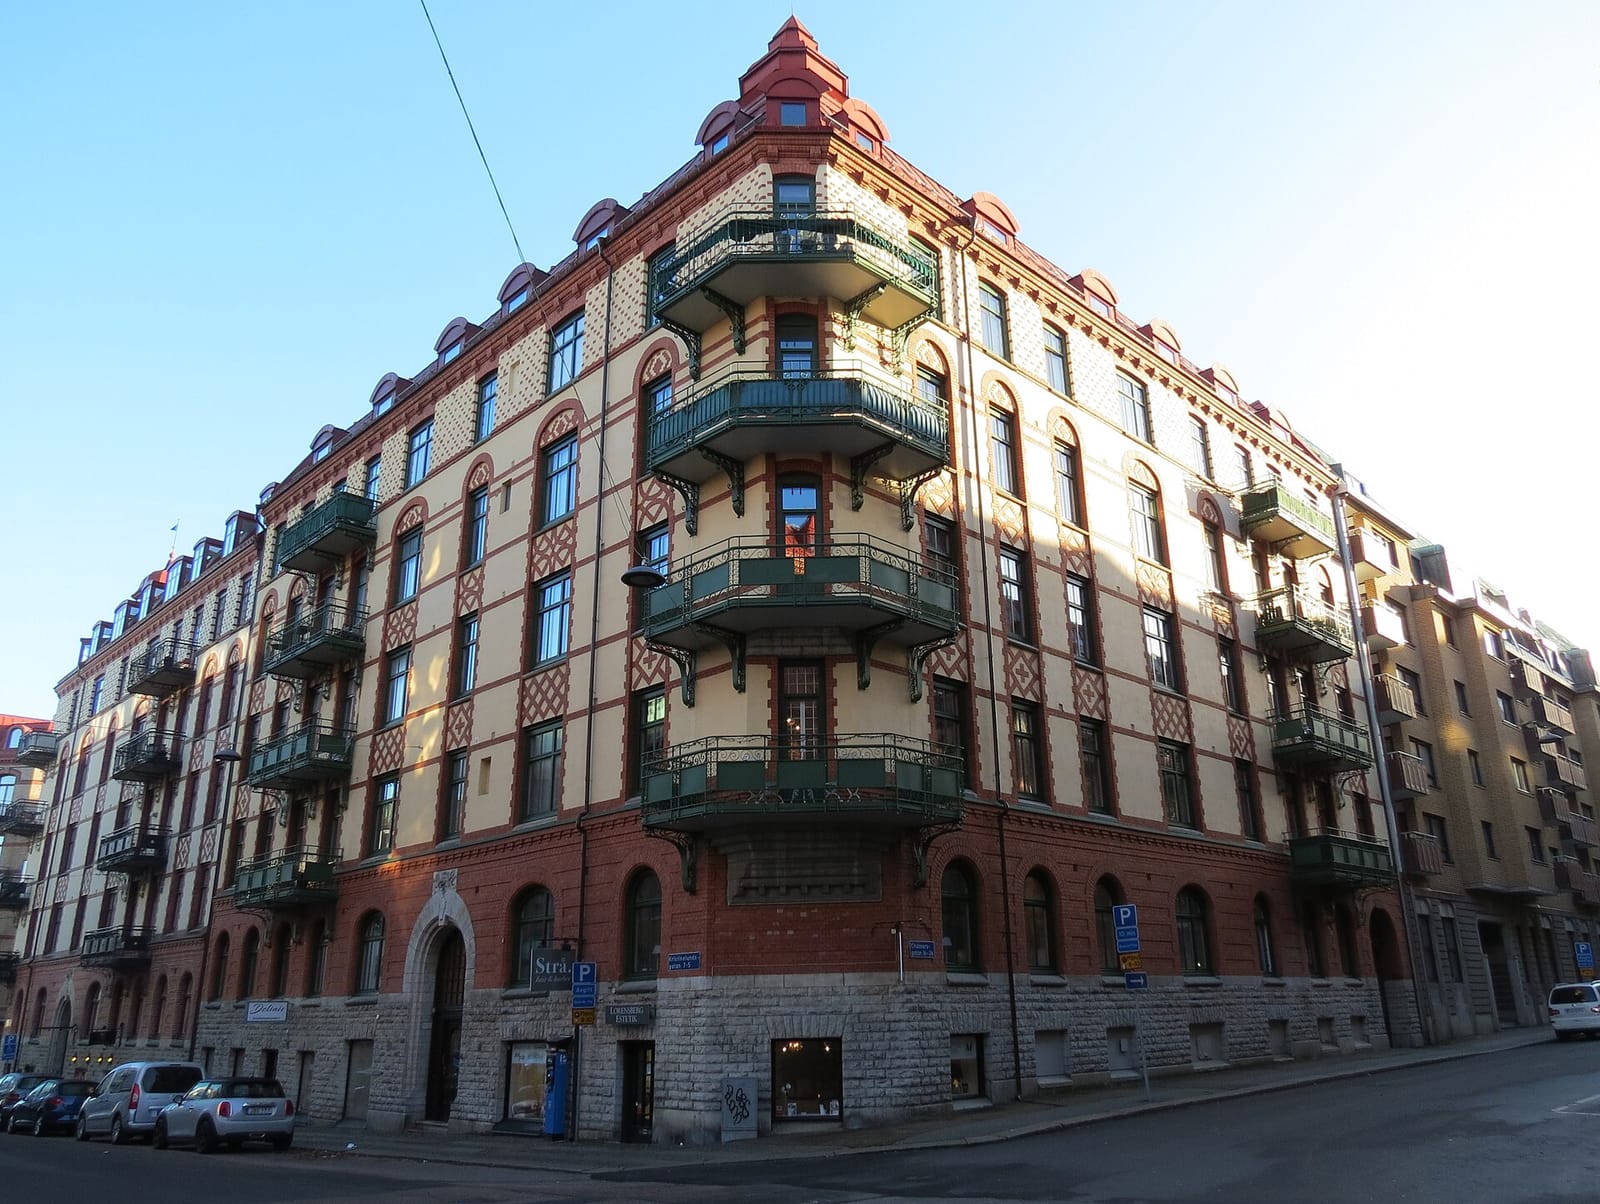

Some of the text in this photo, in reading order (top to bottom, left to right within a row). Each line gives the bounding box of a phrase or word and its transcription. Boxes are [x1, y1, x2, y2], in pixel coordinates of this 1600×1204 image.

[1120, 907, 1131, 925] P
[579, 964, 591, 981] P
[615, 1015, 638, 1023] ESTETIK
